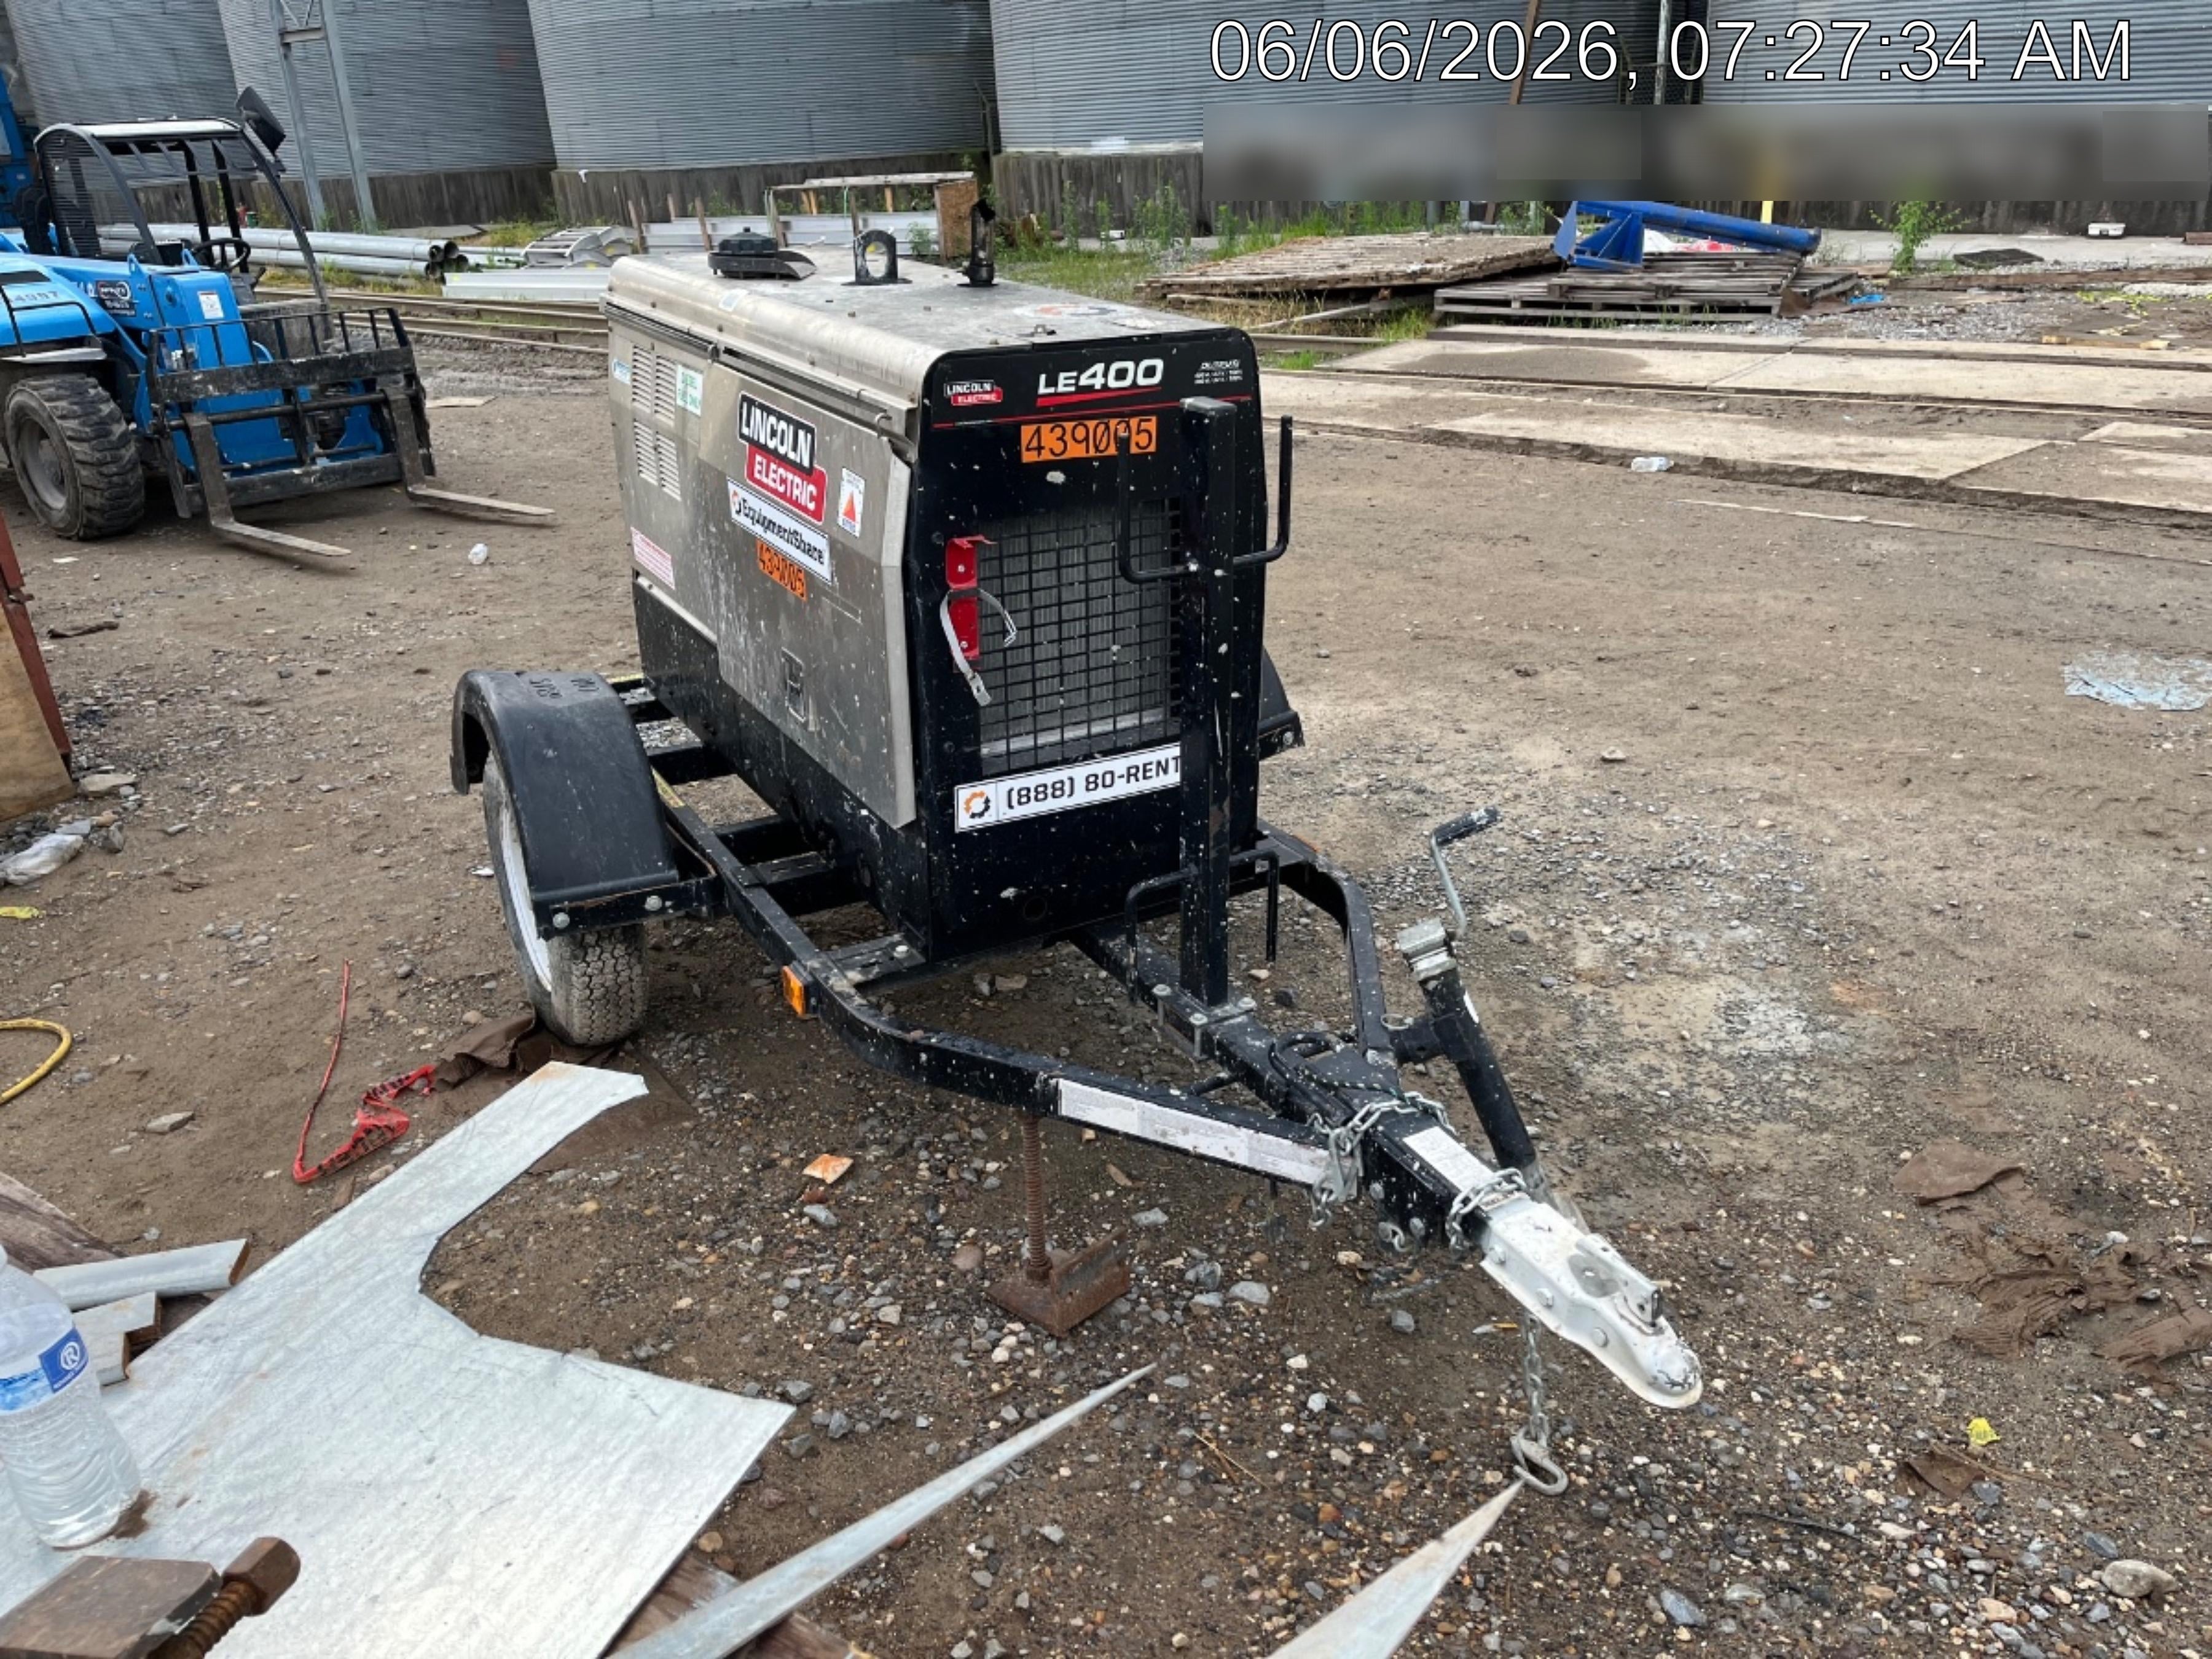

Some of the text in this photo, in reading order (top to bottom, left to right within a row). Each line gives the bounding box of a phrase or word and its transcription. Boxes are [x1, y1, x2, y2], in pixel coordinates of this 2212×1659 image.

[947, 383, 991, 395] LINCOLN
[1037, 358, 1164, 395] LE400
[741, 401, 812, 468] LINCOLN
[753, 453, 818, 511] ELECTRIC
[742, 499, 825, 565] EquipmentShare
[1007, 776, 1075, 809] (888)
